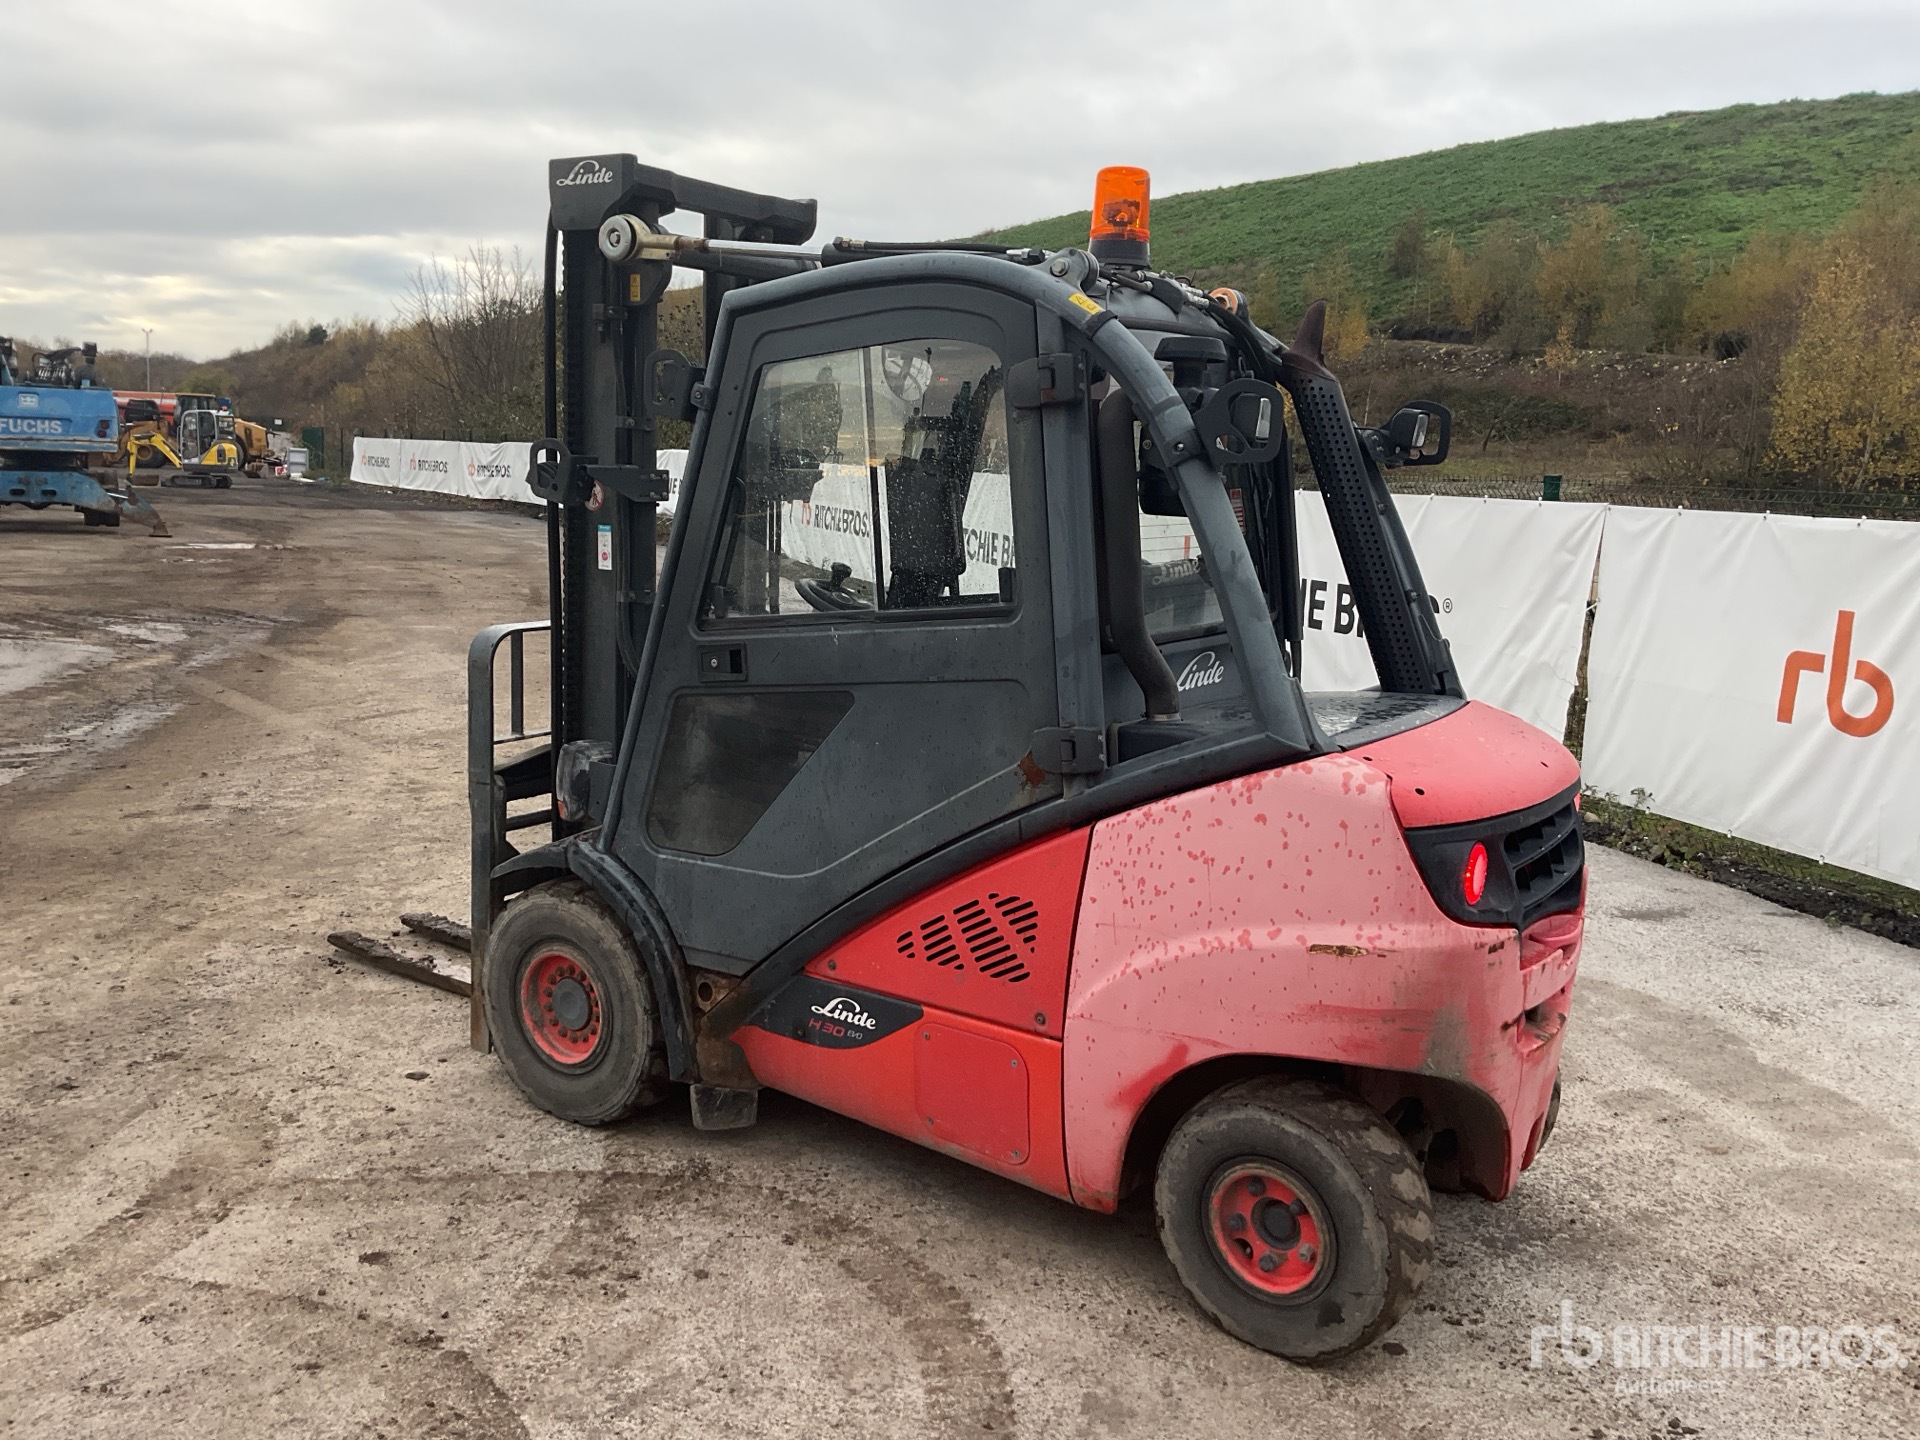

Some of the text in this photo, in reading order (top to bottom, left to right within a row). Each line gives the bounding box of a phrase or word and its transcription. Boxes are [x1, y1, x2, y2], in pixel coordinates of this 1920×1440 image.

[556, 160, 613, 186] Linde
[0, 418, 62, 434] FUCHS
[1152, 558, 1200, 585] Linde
[1177, 651, 1224, 691] Linde
[1777, 610, 1894, 737] rb
[811, 997, 876, 1030] Linde
